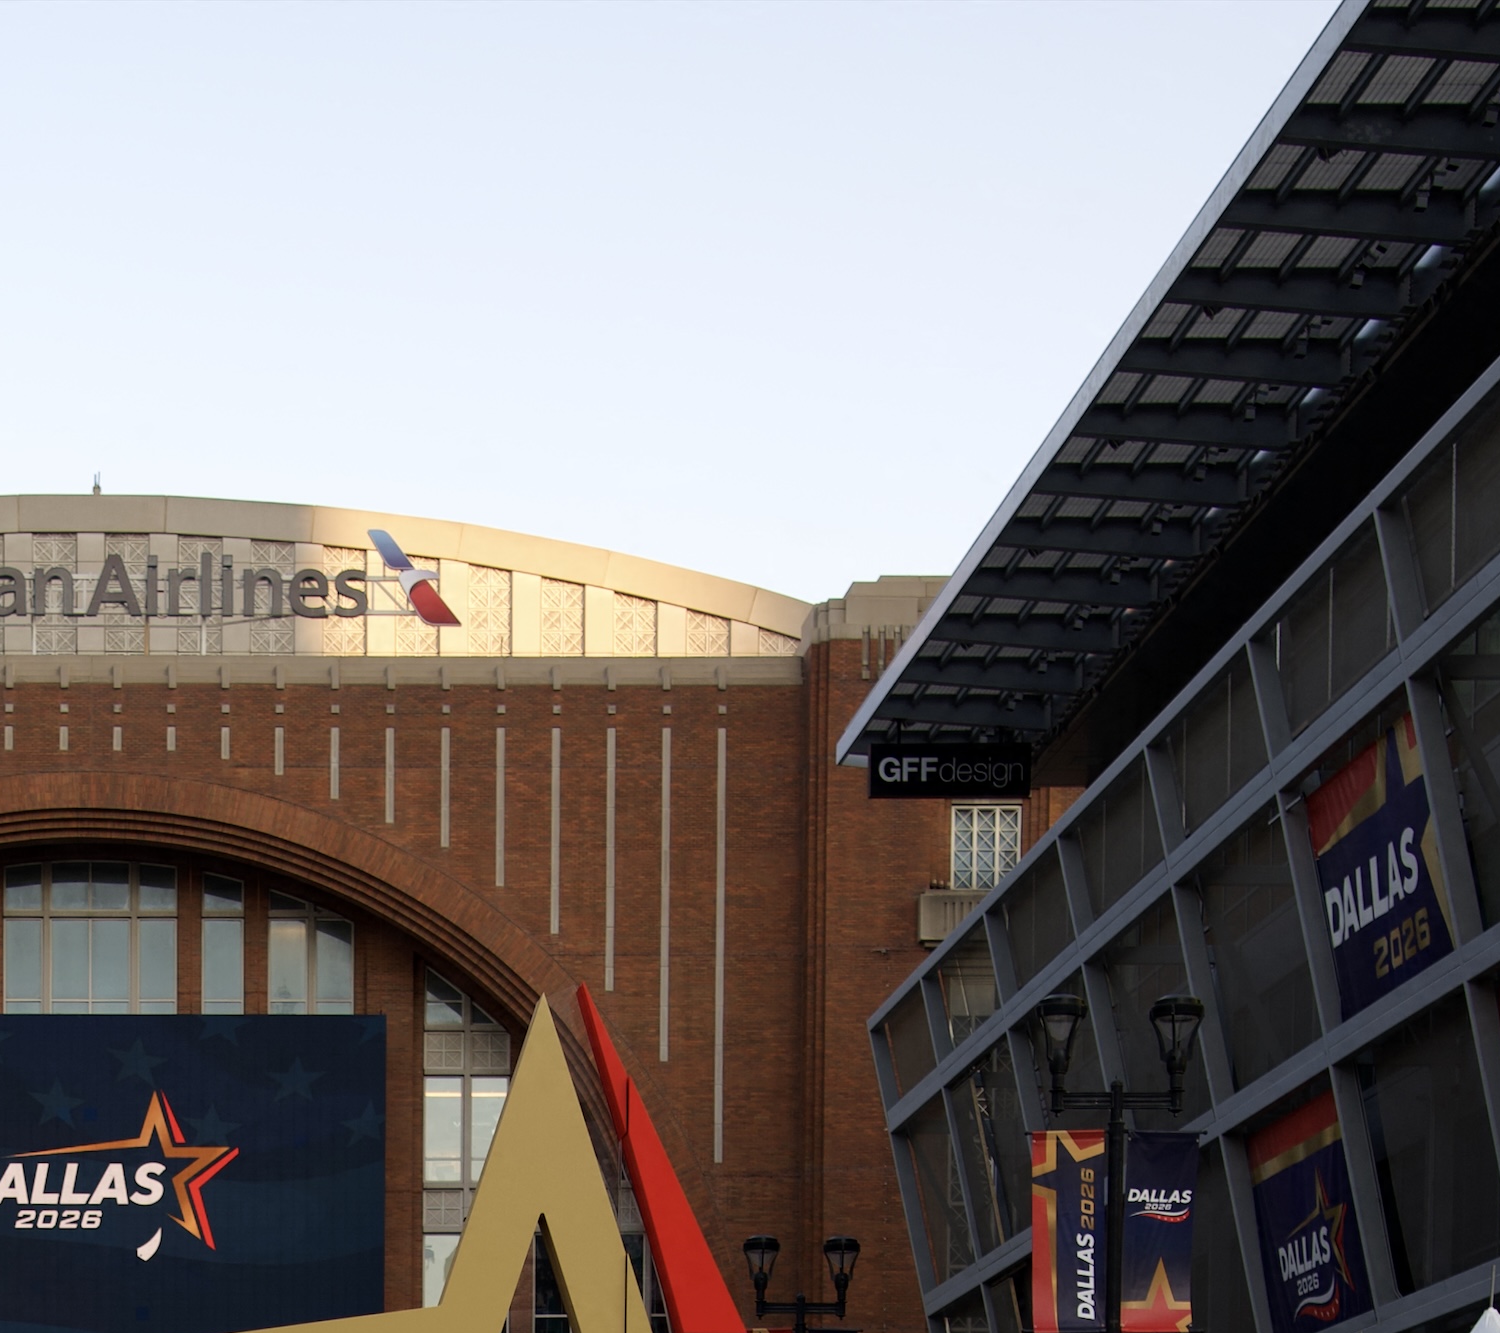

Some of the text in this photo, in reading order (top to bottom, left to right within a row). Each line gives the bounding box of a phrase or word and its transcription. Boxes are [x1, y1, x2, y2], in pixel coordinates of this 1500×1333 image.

[87, 554, 369, 617] Airlines
[1324, 826, 1419, 948] DALLAS
[1373, 908, 1432, 979] 2026
[14, 1209, 102, 1230] 2026
[1127, 1188, 1192, 1205] DALLAS
[1144, 1203, 1172, 1211] 2026
[1076, 1167, 1096, 1321] DALLAS 2026
[1278, 1225, 1331, 1282] DALLAS
[1297, 1272, 1320, 1296] 2026
